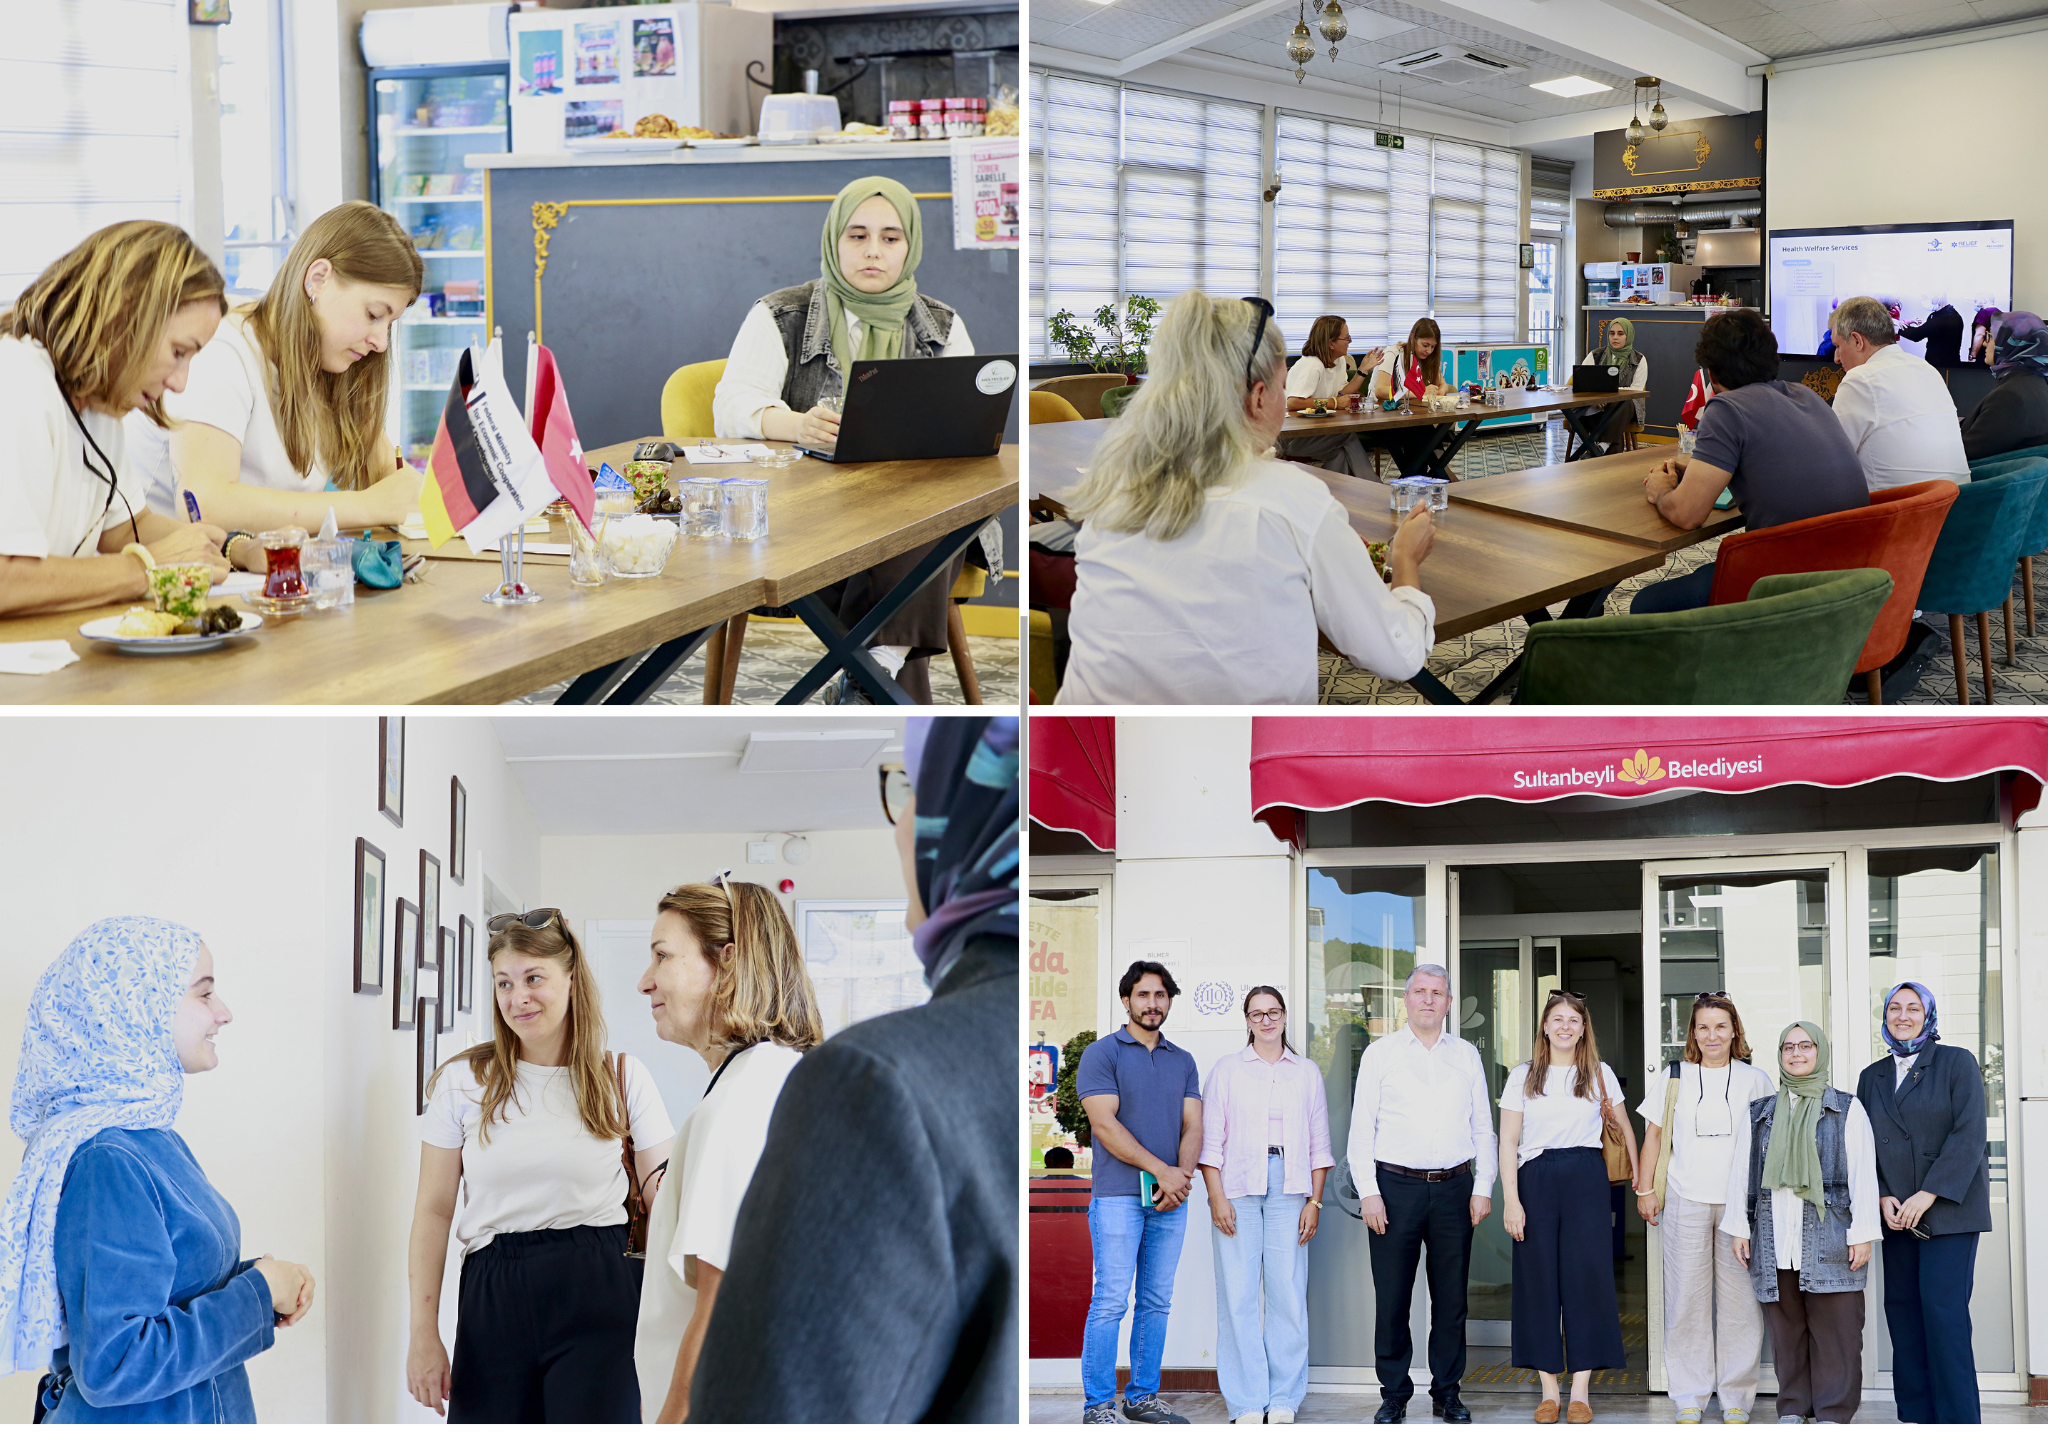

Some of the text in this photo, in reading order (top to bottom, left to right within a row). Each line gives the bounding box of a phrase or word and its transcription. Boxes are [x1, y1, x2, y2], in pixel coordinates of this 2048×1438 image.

[975, 173, 1006, 183] SARELLE
[481, 401, 513, 465] Federal Ministry
[473, 407, 525, 511] for Economic Cooperation
[1513, 755, 1763, 788] Sultanbeyli Belediyesi
[1029, 939, 1069, 975] da
[1206, 988, 1223, 1005] ILO
